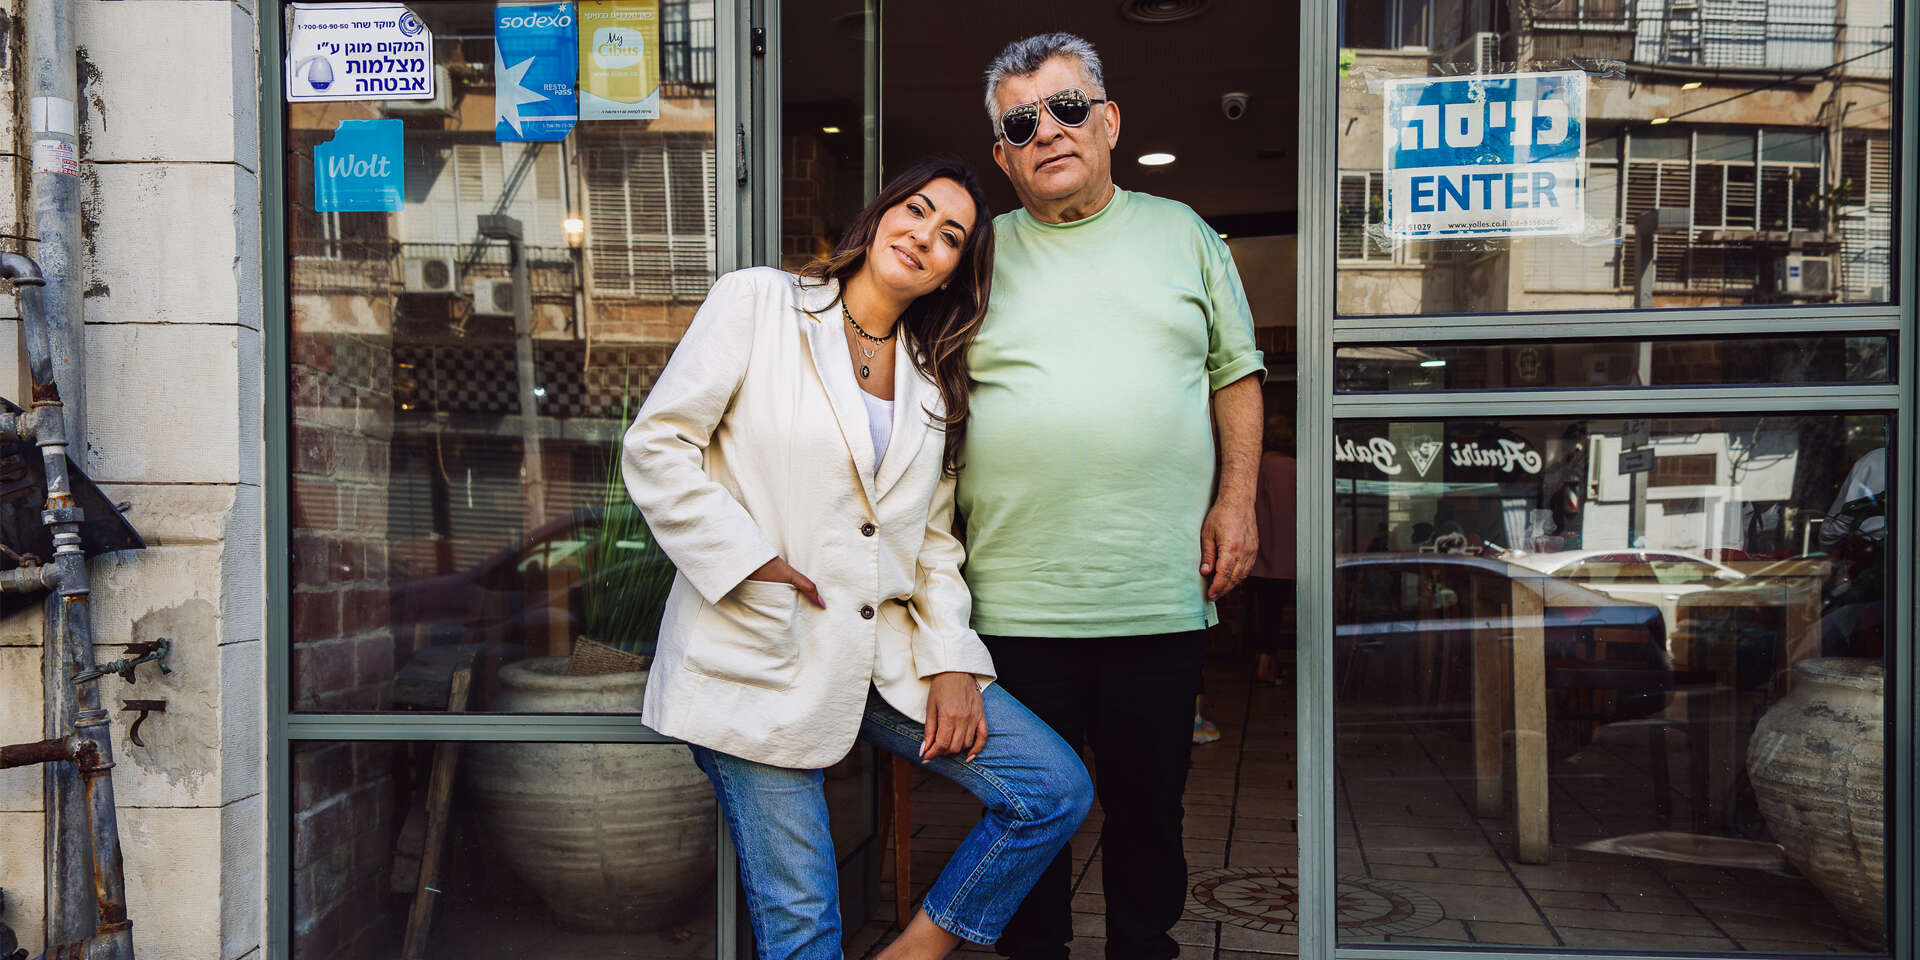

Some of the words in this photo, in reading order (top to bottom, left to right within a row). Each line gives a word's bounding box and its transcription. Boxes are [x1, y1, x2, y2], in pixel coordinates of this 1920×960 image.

[351, 21, 371, 29] שחר
[374, 20, 396, 29] מוקד
[499, 12, 571, 29] sodexo
[606, 32, 624, 47] My
[345, 42, 373, 56] מוגן
[377, 41, 425, 55] המקום
[598, 43, 639, 57] Cibus
[345, 56, 425, 74] מצלמות
[355, 77, 425, 92] אבטחה
[543, 83, 567, 91] RESTO
[1401, 99, 1569, 150] כניסה
[328, 153, 391, 178] Wolt
[1410, 171, 1559, 213] ENTER
[1448, 220, 1507, 231] www.yolles.co.il
